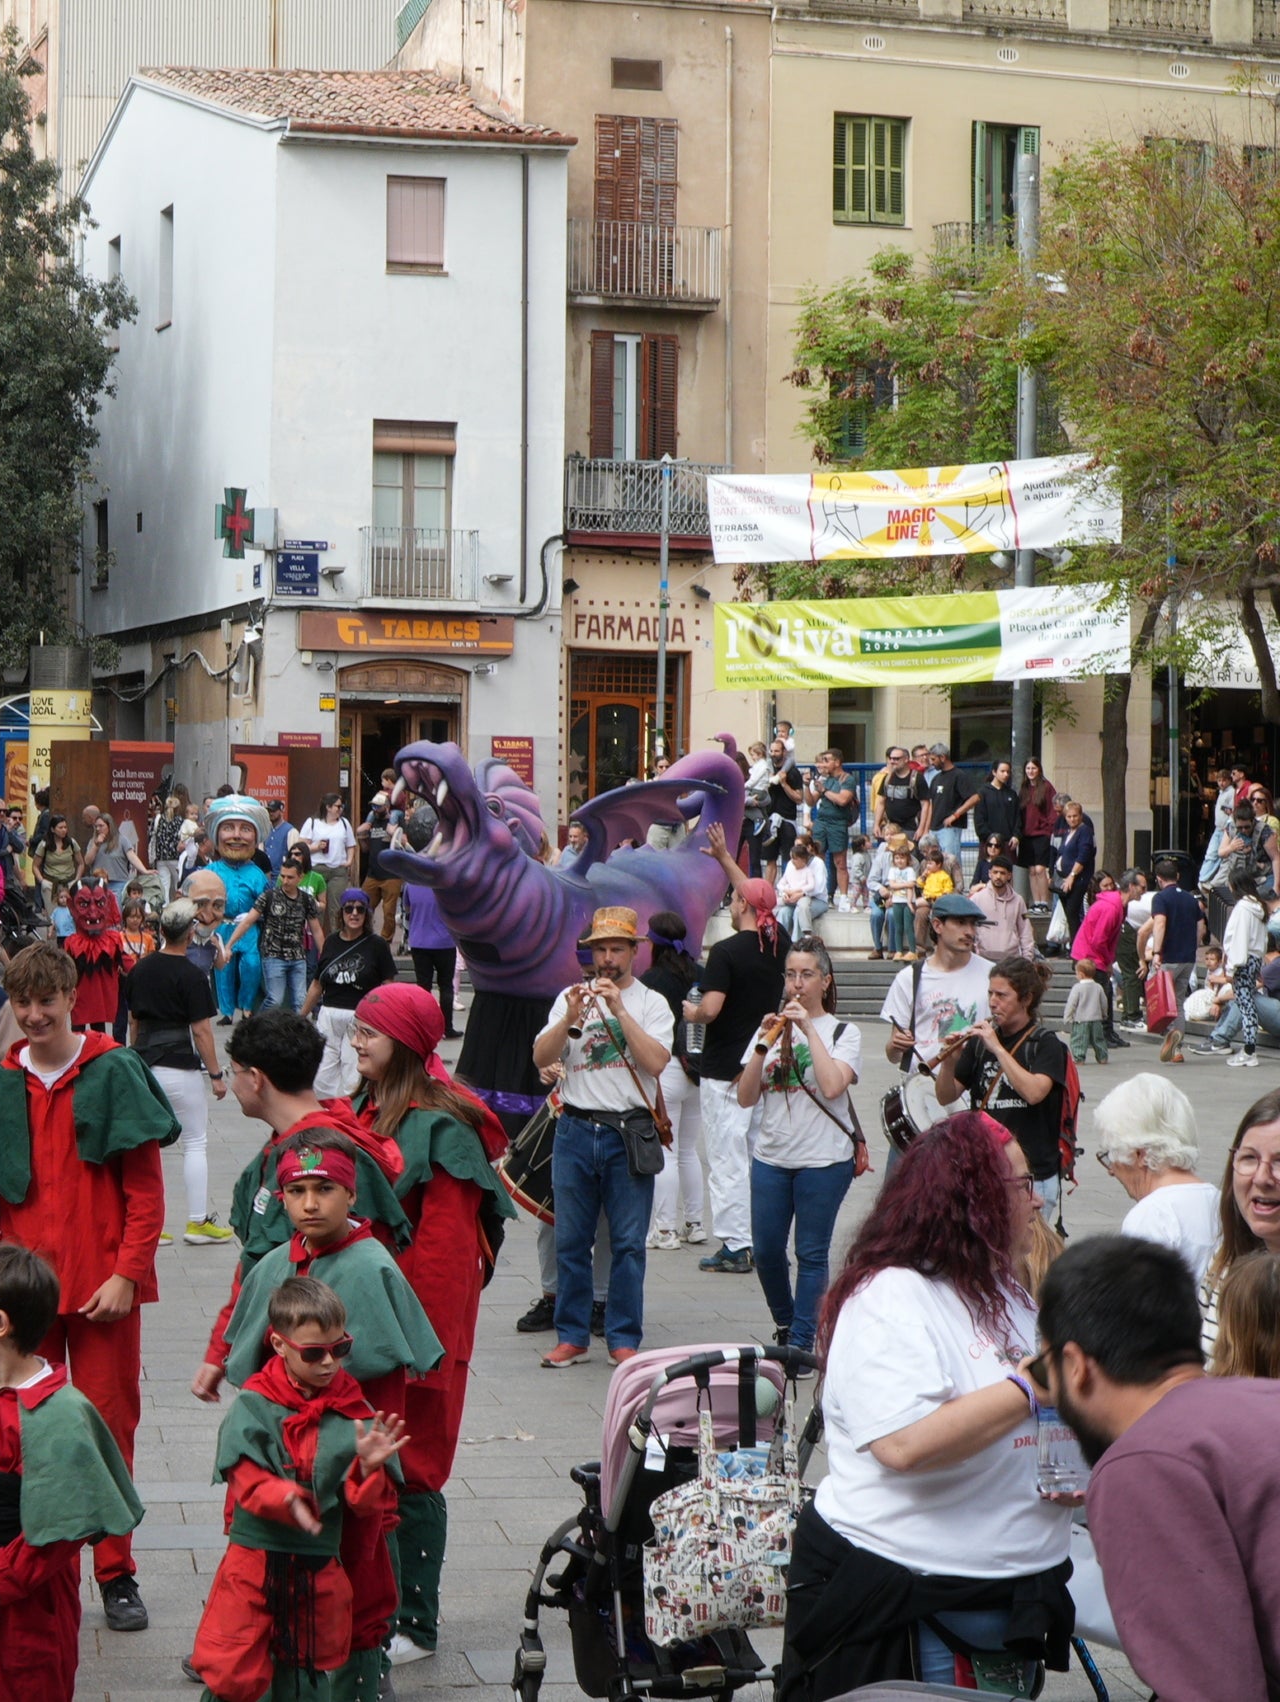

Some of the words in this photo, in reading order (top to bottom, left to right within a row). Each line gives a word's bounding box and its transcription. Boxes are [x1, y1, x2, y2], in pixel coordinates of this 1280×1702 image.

[887, 507, 936, 524] MAGIC
[714, 523, 759, 532] TERRASSA
[886, 524, 919, 541] LINE
[1009, 607, 1060, 618] DISSABTE
[381, 619, 481, 640] TABACS
[1009, 622, 1037, 633] Plaça
[1040, 622, 1053, 631] de
[865, 628, 945, 640] TERRASSA
[865, 642, 900, 651] 2026
[923, 656, 939, 665] MÉS
[32, 697, 54, 706] LOVE
[31, 706, 56, 716] LOCAL
[112, 769, 125, 778] Cada
[126, 769, 137, 778] llum
[138, 771, 154, 779] encesa
[112, 780, 118, 788] és
[126, 780, 145, 790] comerç
[266, 775, 286, 786] JUNTS
[112, 791, 124, 802] que
[125, 790, 147, 803] batega
